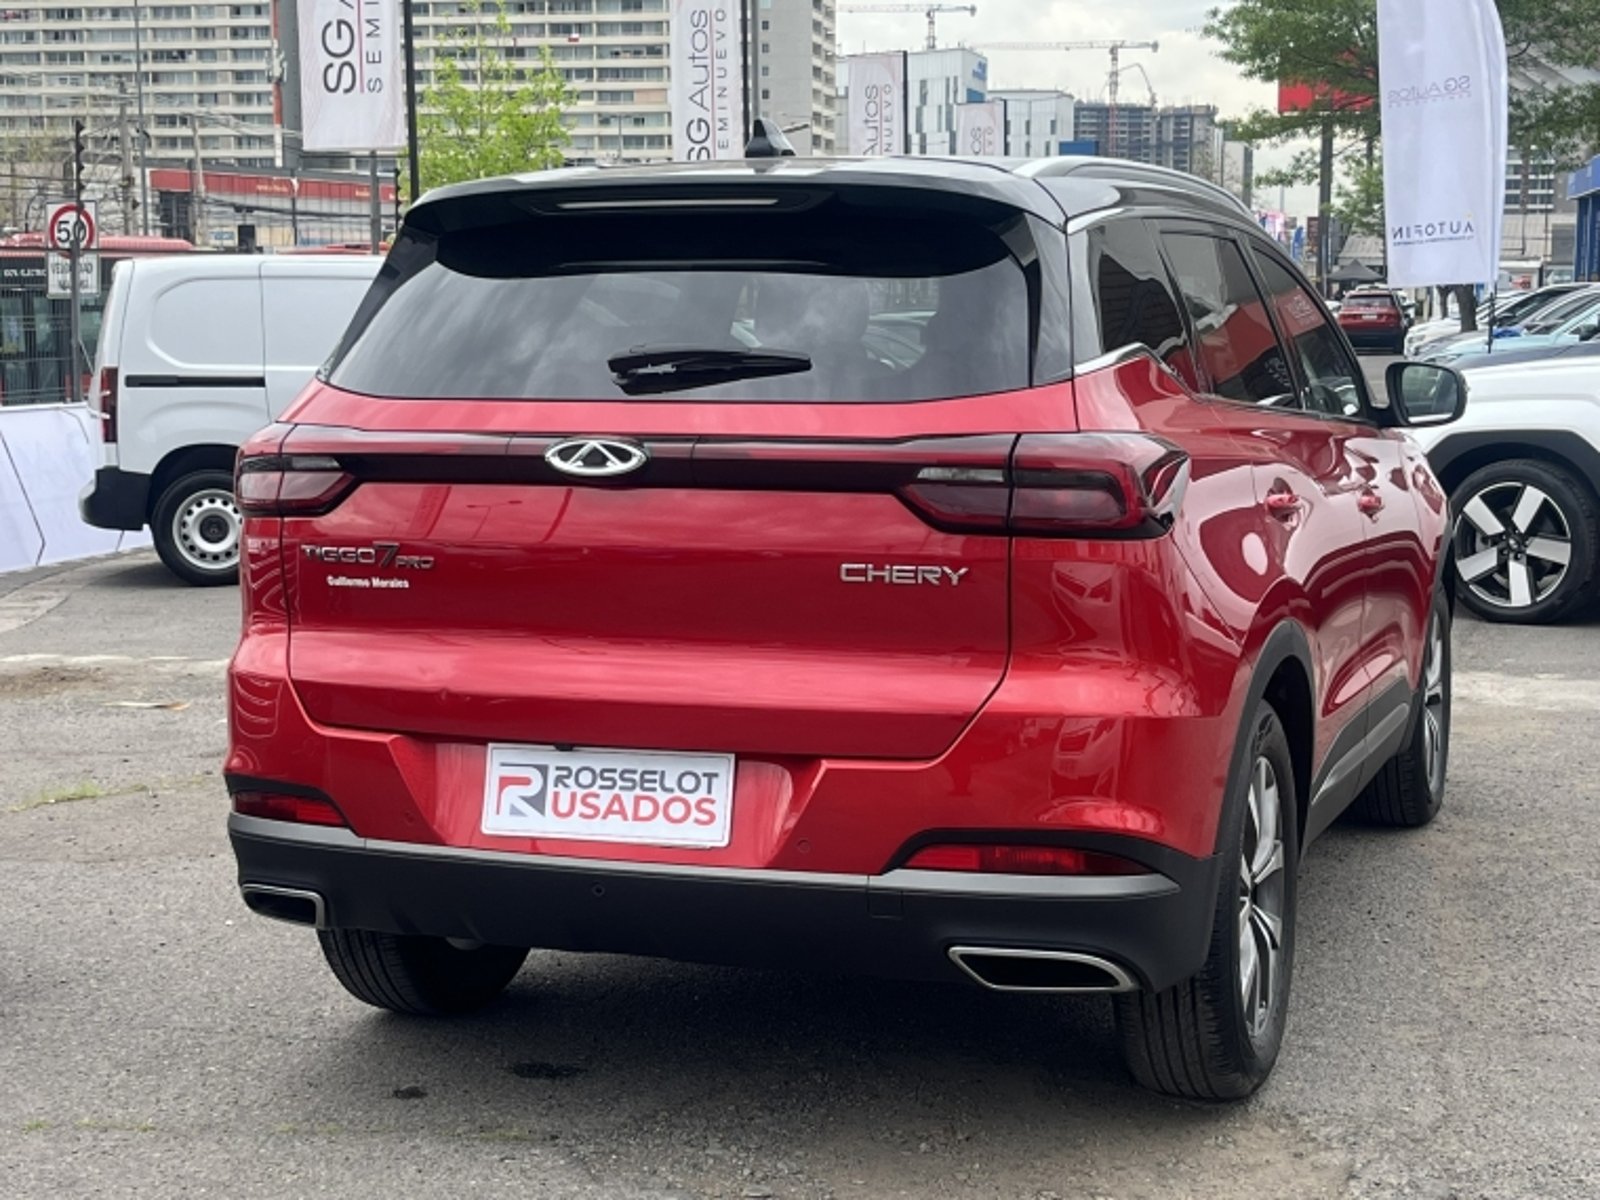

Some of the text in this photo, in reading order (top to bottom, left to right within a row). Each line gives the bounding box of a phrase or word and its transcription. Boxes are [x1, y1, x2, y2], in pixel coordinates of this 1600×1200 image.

[321, 18, 356, 94] SG
[364, 1, 383, 93] SEMI
[688, 9, 710, 112] Autos
[57, 220, 87, 243] 50
[373, 541, 399, 567] 7
[396, 555, 434, 568] PRO
[840, 563, 968, 586] CHERY
[553, 766, 719, 794] ROSSELOT
[551, 791, 717, 826] USADOS
